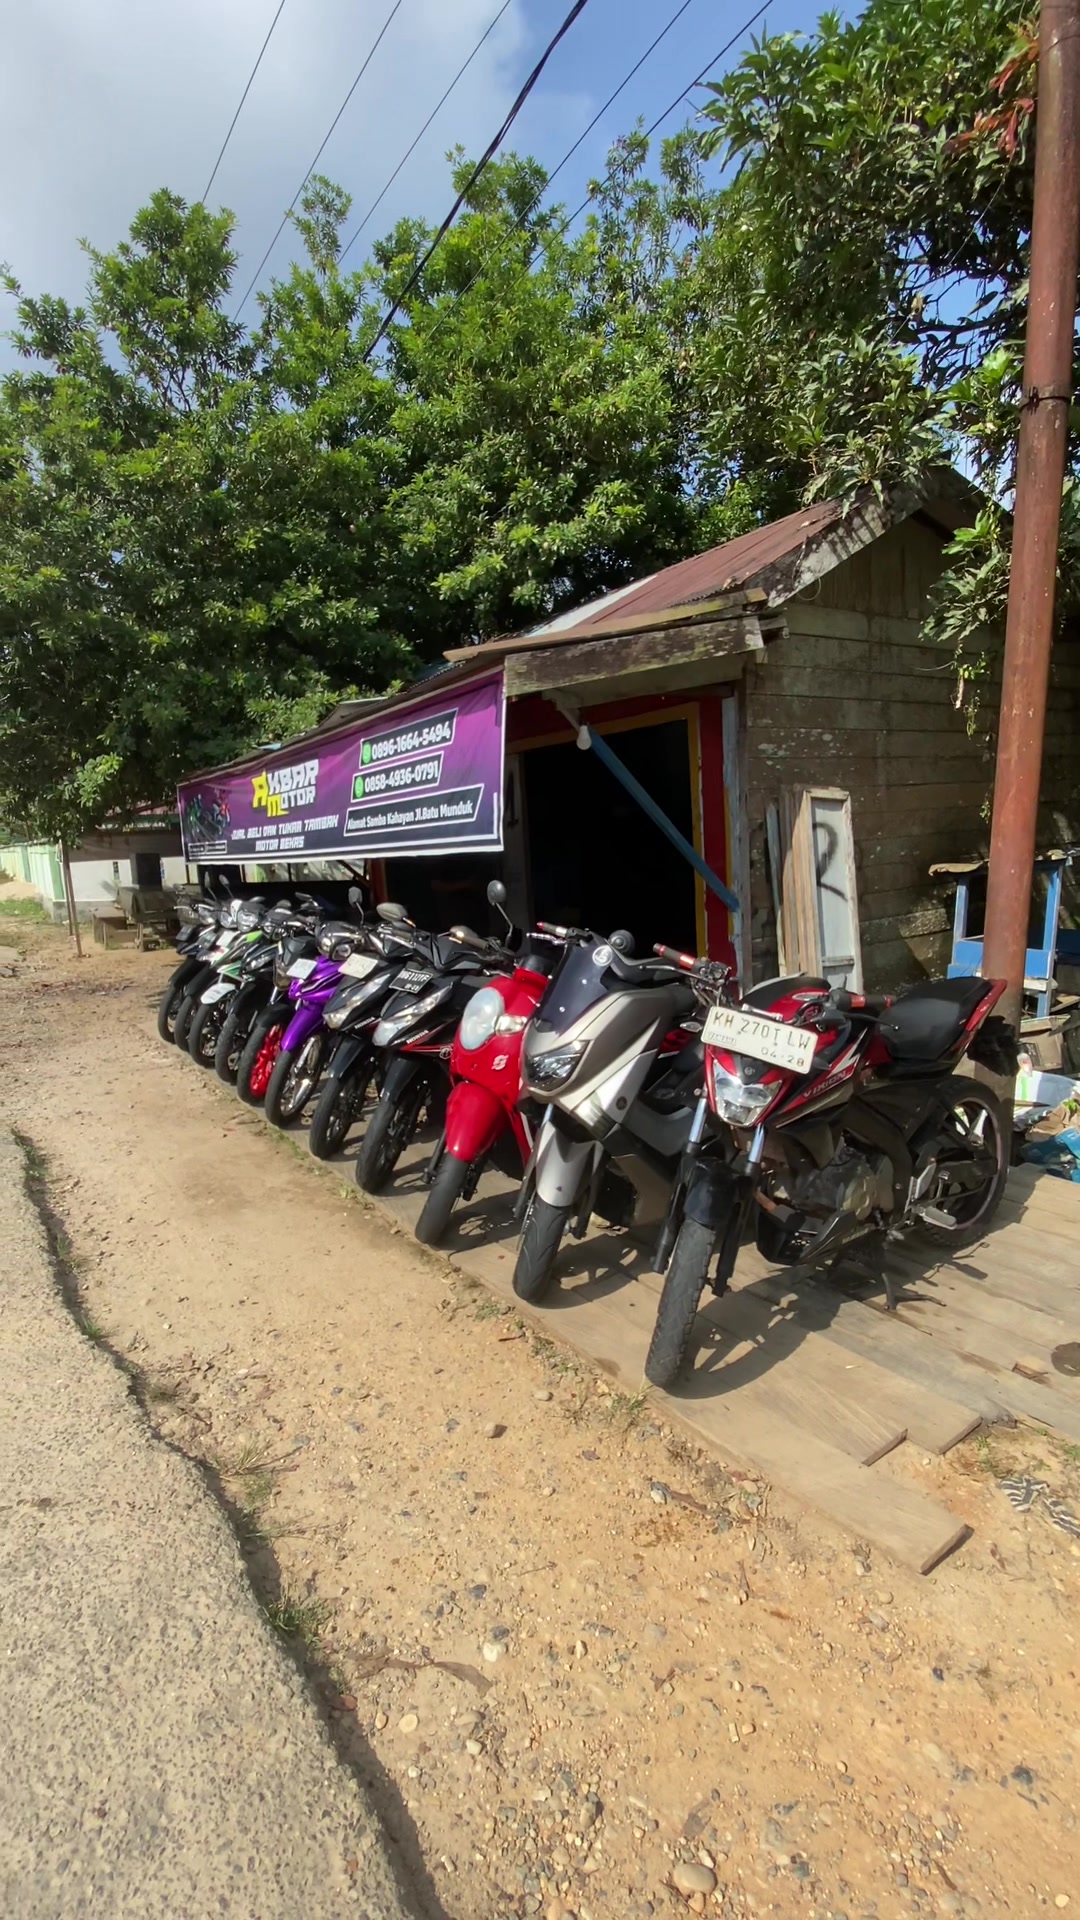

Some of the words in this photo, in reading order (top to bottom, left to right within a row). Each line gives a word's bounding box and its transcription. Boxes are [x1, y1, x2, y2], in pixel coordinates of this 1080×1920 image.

[371, 721, 451, 760] 0896-1664-5494
[251, 758, 319, 808] AKBAR
[364, 761, 438, 793] 0858-4936-0791
[267, 785, 316, 818] MOTOR
[440, 800, 473, 818] Munduk
[255, 839, 279, 851] MOTOR
[713, 1012, 735, 1028] KH
[787, 1030, 811, 1050] LW
